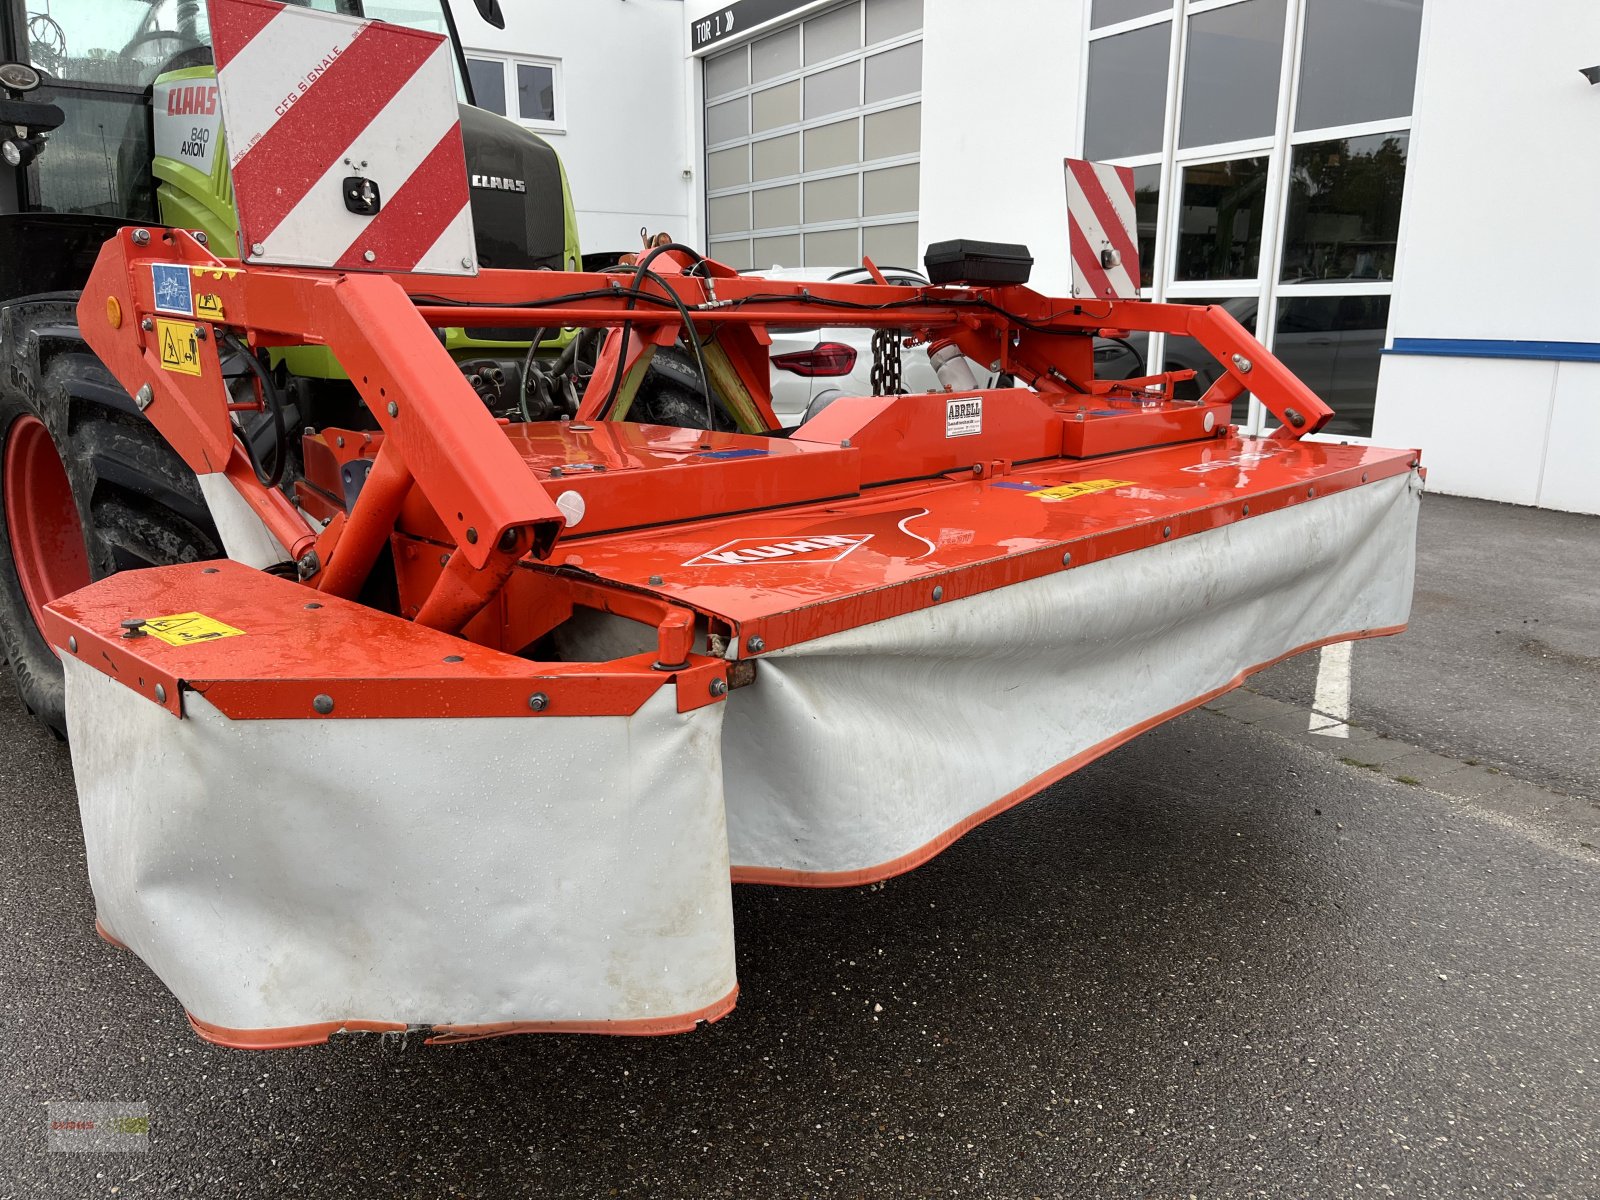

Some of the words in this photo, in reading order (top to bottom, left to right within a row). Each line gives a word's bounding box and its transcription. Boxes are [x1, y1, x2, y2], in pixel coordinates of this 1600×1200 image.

[696, 20, 711, 43] TOR
[715, 16, 721, 36] 1
[275, 92, 298, 116] CFG
[298, 45, 342, 92] SIGNALE
[168, 86, 218, 116] CLAAS
[191, 127, 209, 143] 840
[181, 141, 205, 157] AXION
[472, 174, 525, 192] CLAAS
[949, 402, 980, 418] ABRELL
[701, 535, 862, 564] KUHN
